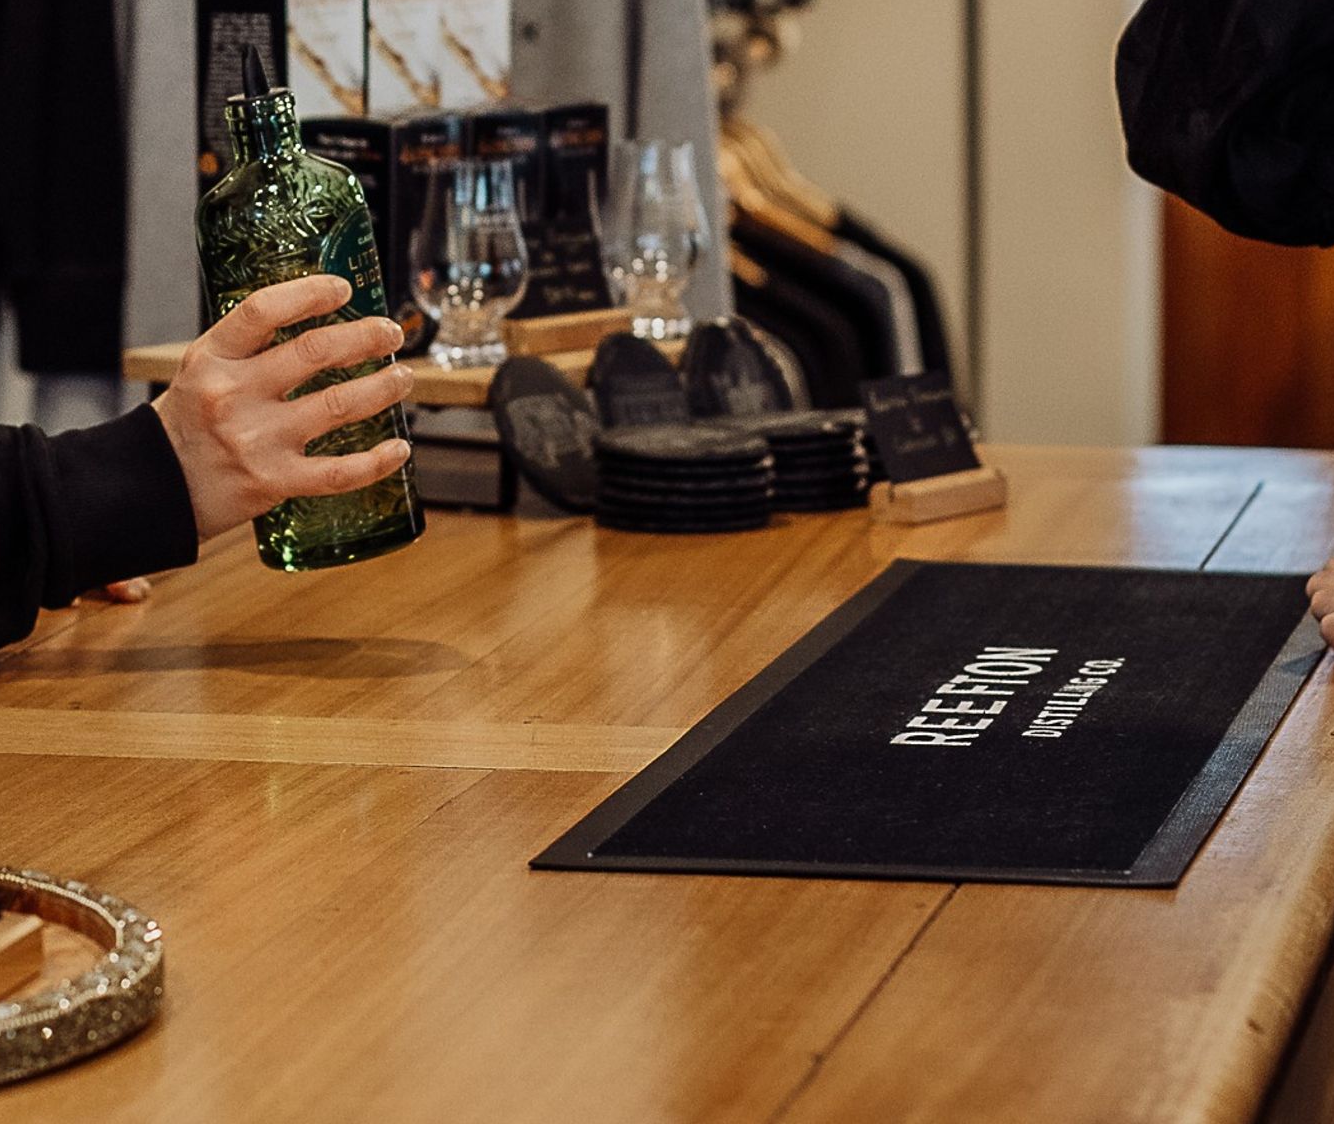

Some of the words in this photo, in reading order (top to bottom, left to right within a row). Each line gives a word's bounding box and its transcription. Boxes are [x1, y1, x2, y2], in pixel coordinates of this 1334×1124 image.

[890, 646, 1059, 747] REEFTON
[1021, 677, 1108, 738] DISTILLING
[1078, 657, 1126, 676] CO.
